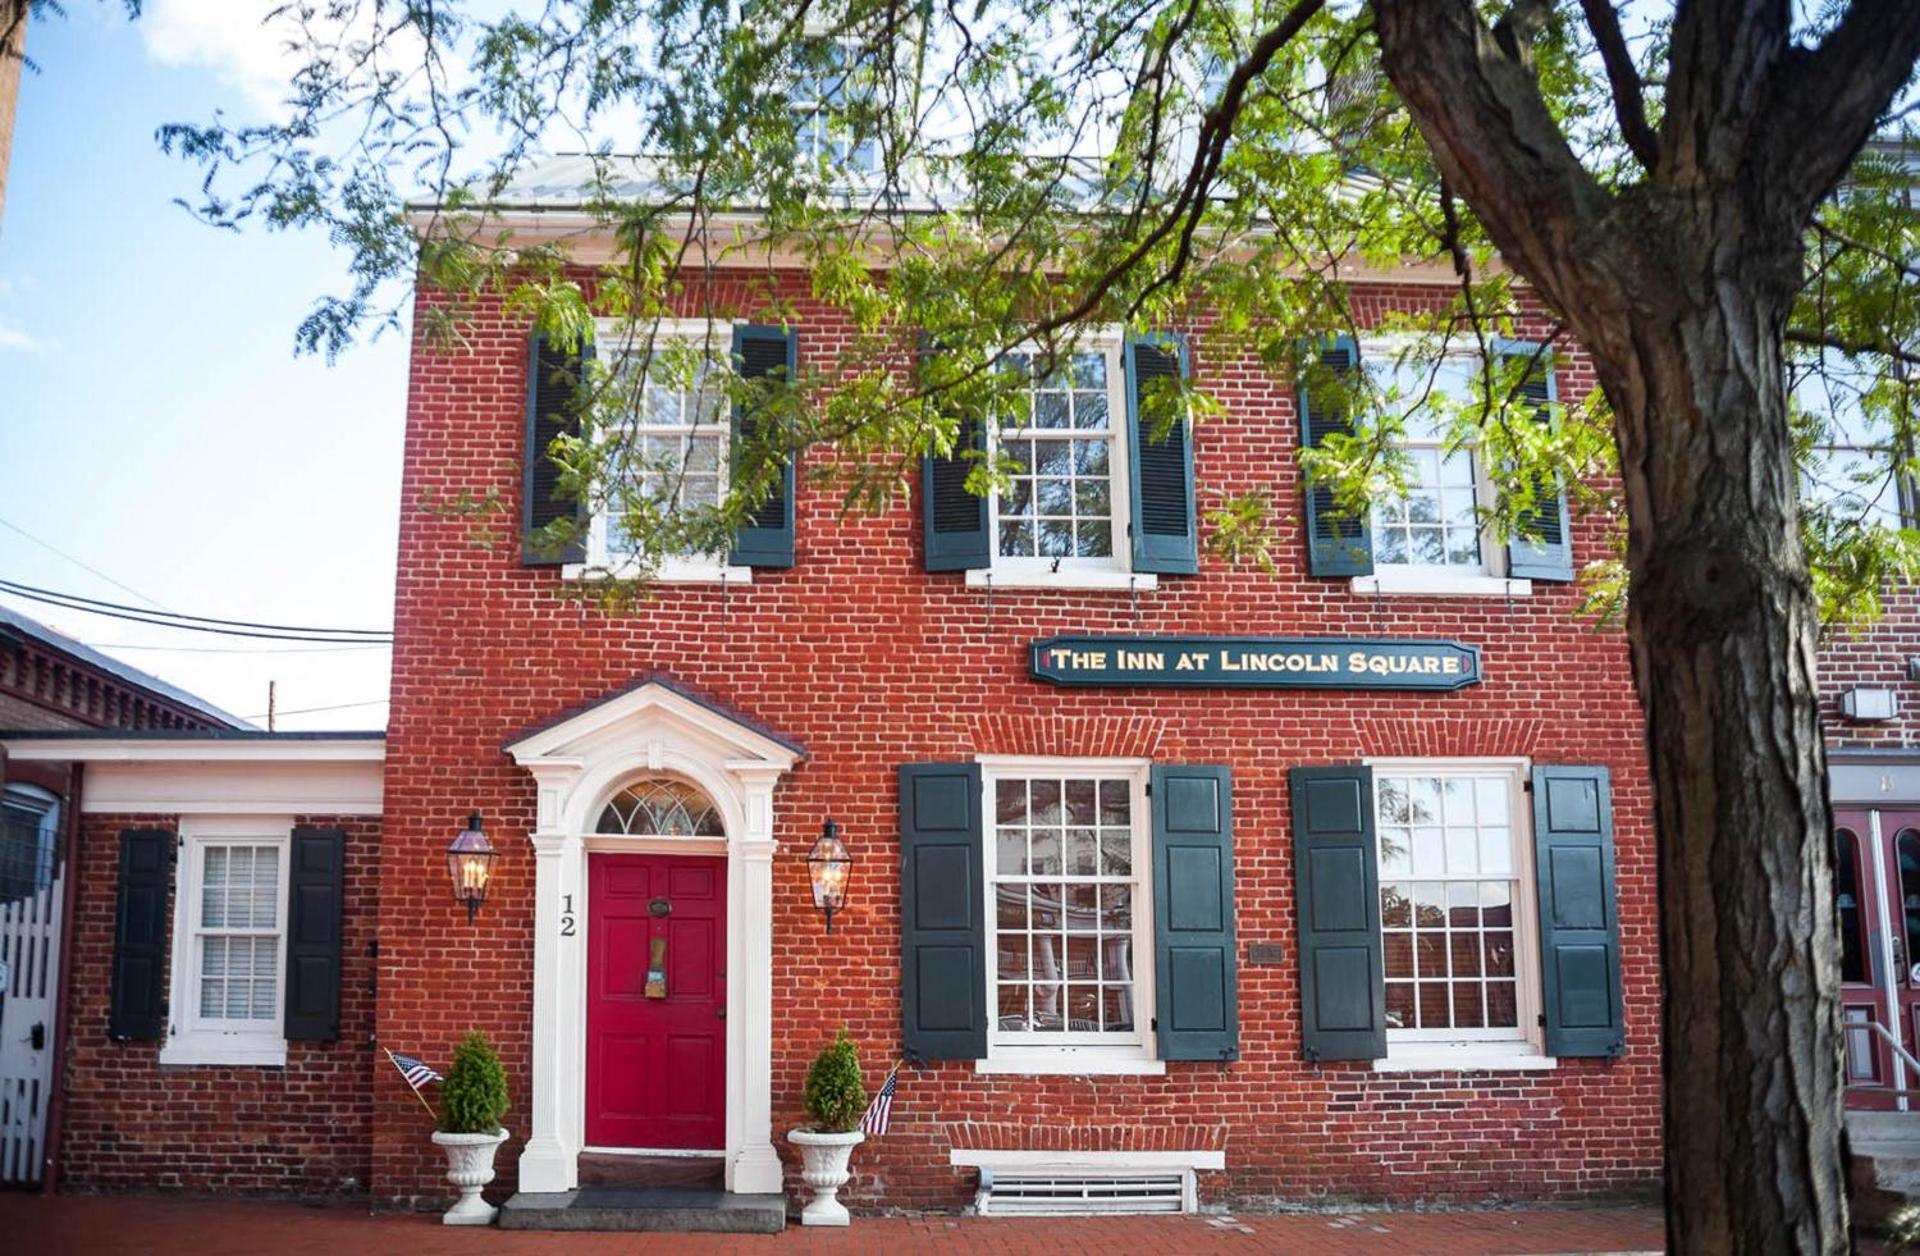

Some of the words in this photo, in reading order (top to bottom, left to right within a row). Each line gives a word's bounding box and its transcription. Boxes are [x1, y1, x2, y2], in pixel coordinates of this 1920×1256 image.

[1051, 649, 1107, 670] THE
[1117, 650, 1165, 670] INN
[1175, 652, 1210, 671] AT
[1220, 650, 1339, 671] LINCOLN
[1348, 652, 1459, 675] SQUARE
[560, 894, 577, 937] 12
